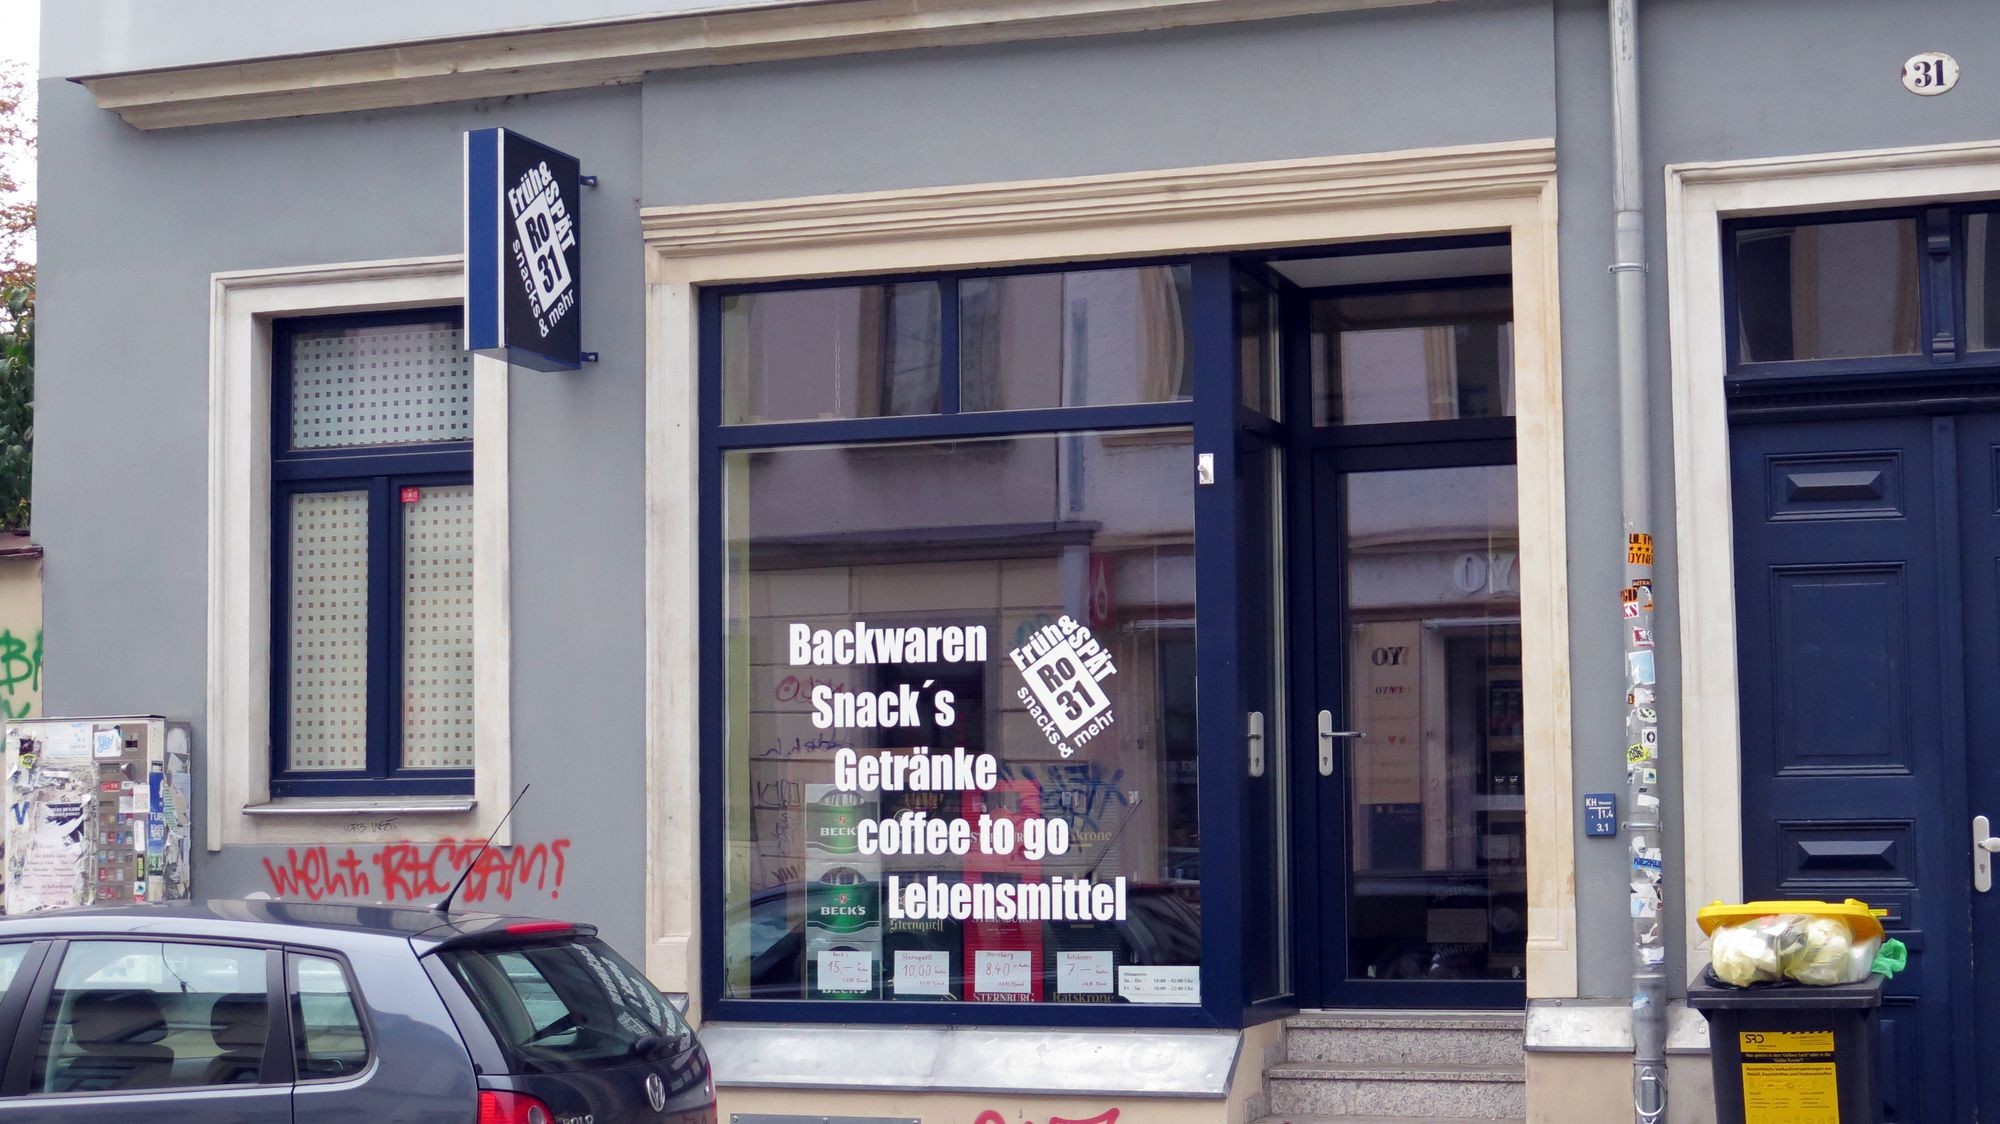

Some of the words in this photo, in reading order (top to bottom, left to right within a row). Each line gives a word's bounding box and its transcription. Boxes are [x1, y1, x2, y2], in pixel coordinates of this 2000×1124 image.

[1914, 60, 1945, 87] 31
[525, 212, 550, 252] RO
[544, 181, 575, 251] SPÄT
[512, 238, 540, 318] snacks
[549, 289, 575, 327] mehr
[537, 249, 562, 294] 31
[789, 621, 987, 666] Backwaren
[1068, 626, 1117, 684] SPÄT
[1036, 656, 1076, 693] RO
[1016, 685, 1060, 746] snacks
[1057, 742, 1074, 759] &
[1074, 709, 1116, 748] mehr
[1056, 684, 1095, 721] 31
[834, 747, 997, 792] Getränke
[1586, 798, 1597, 806] KH
[857, 811, 970, 855] coffee
[978, 814, 1020, 855] to
[1023, 817, 1069, 860] go
[888, 875, 1126, 921] Lebensmittel
[974, 993, 1034, 1002] STERNBURG
